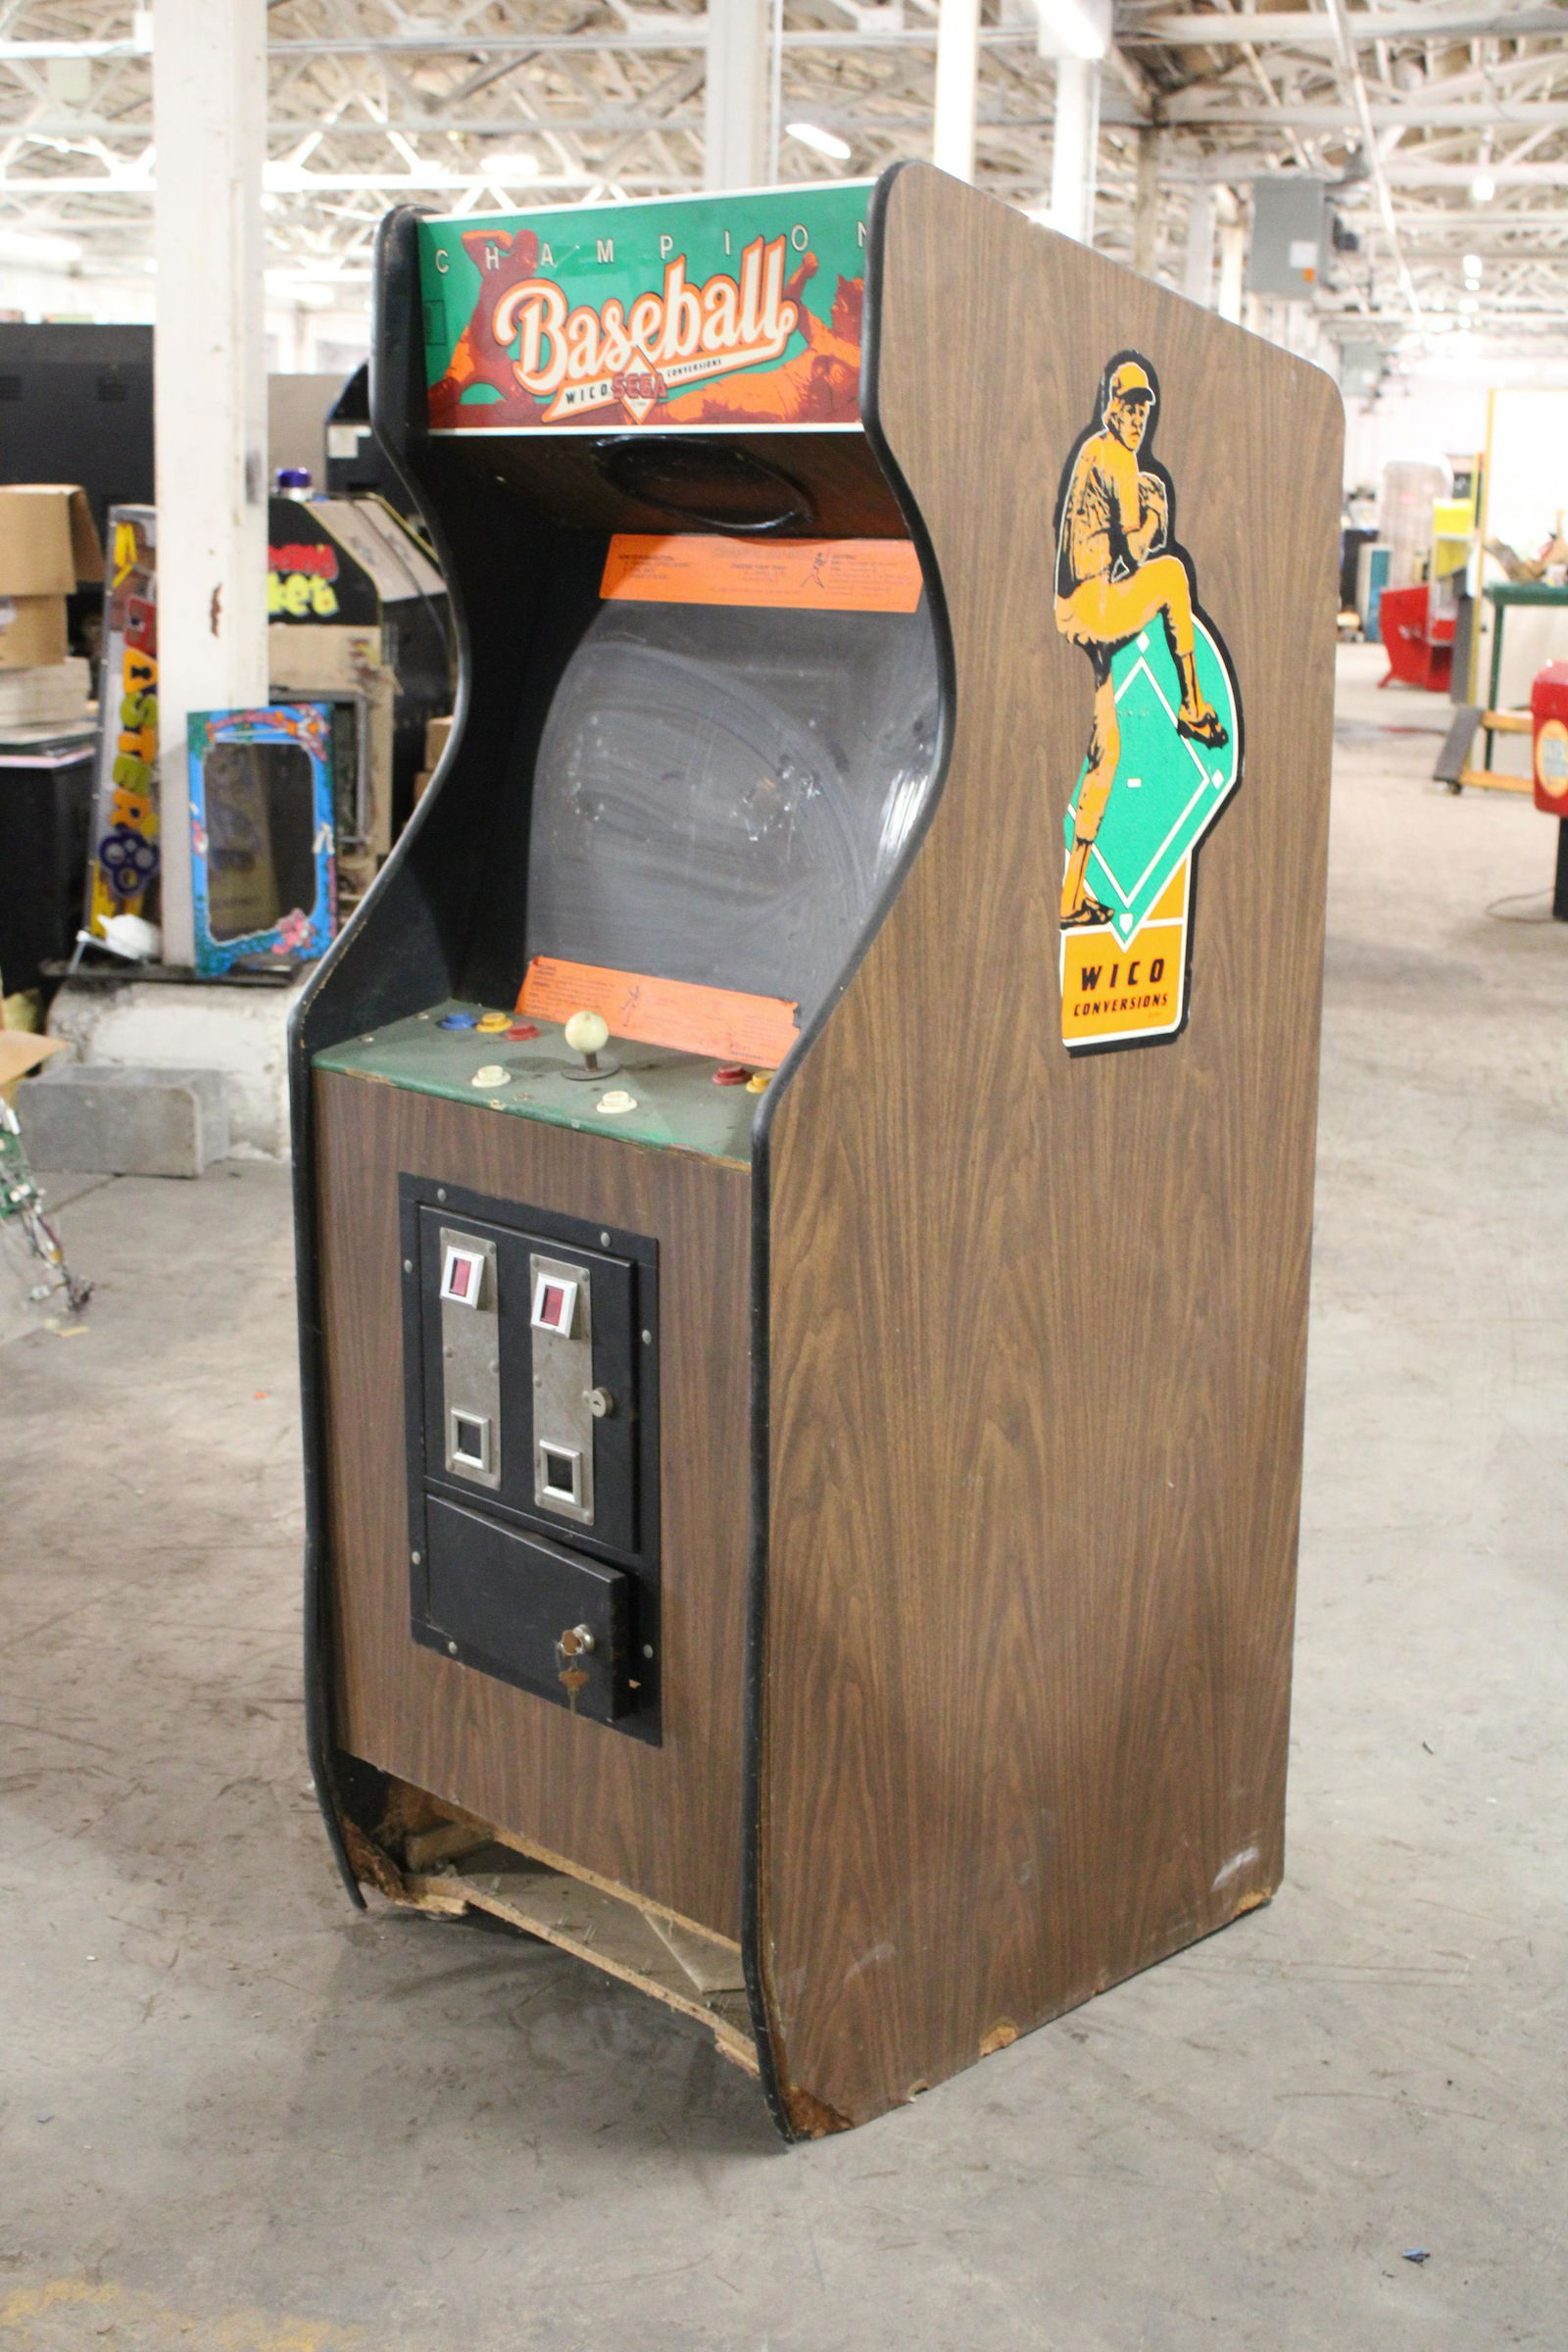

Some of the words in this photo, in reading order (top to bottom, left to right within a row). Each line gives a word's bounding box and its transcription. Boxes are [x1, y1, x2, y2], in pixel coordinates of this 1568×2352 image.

[493, 235, 798, 395] Baseball
[565, 383, 609, 405] WICO
[612, 371, 668, 400] SEGA
[1081, 957, 1165, 992] WICO
[1073, 993, 1168, 1017] CONVERSIONS
